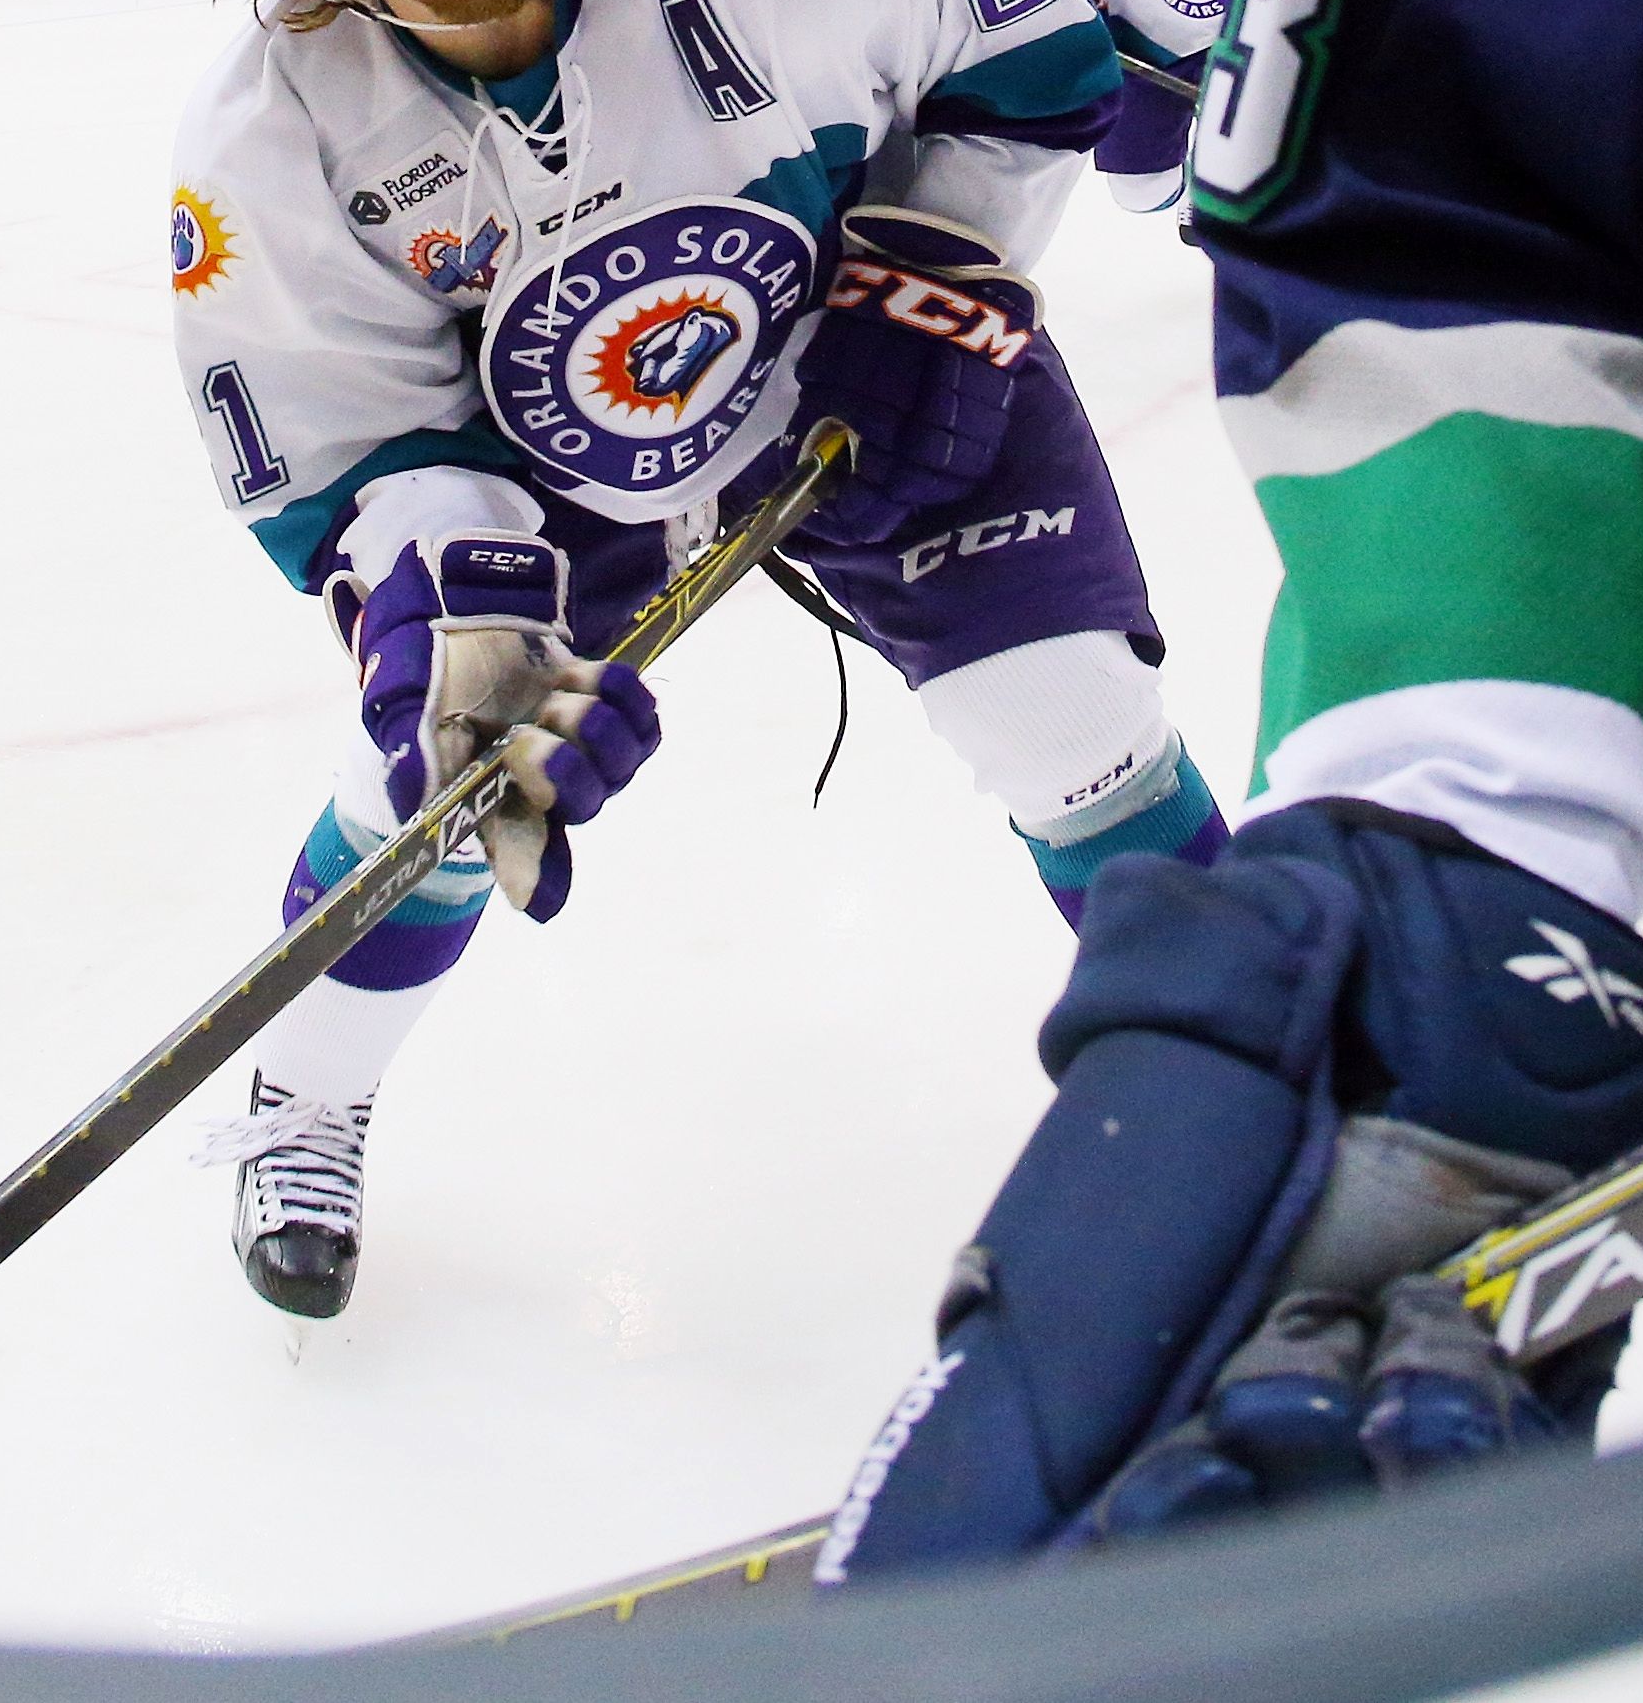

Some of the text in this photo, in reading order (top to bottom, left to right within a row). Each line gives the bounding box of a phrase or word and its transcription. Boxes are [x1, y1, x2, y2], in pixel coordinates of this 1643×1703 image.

[382, 152, 448, 197] FLORIDA
[393, 163, 468, 212] HOSPITAL
[673, 225, 802, 322] SOLAR
[826, 260, 1032, 368] CCM
[510, 245, 647, 455] ORLANDO
[204, 362, 288, 504] 1
[630, 356, 777, 482] BEARS
[469, 549, 536, 566] CCM
[899, 507, 1076, 584] CCM
[1064, 751, 1134, 805] CCM
[353, 767, 518, 928] ULTRA TACK
[815, 1350, 967, 1584] Reebok
